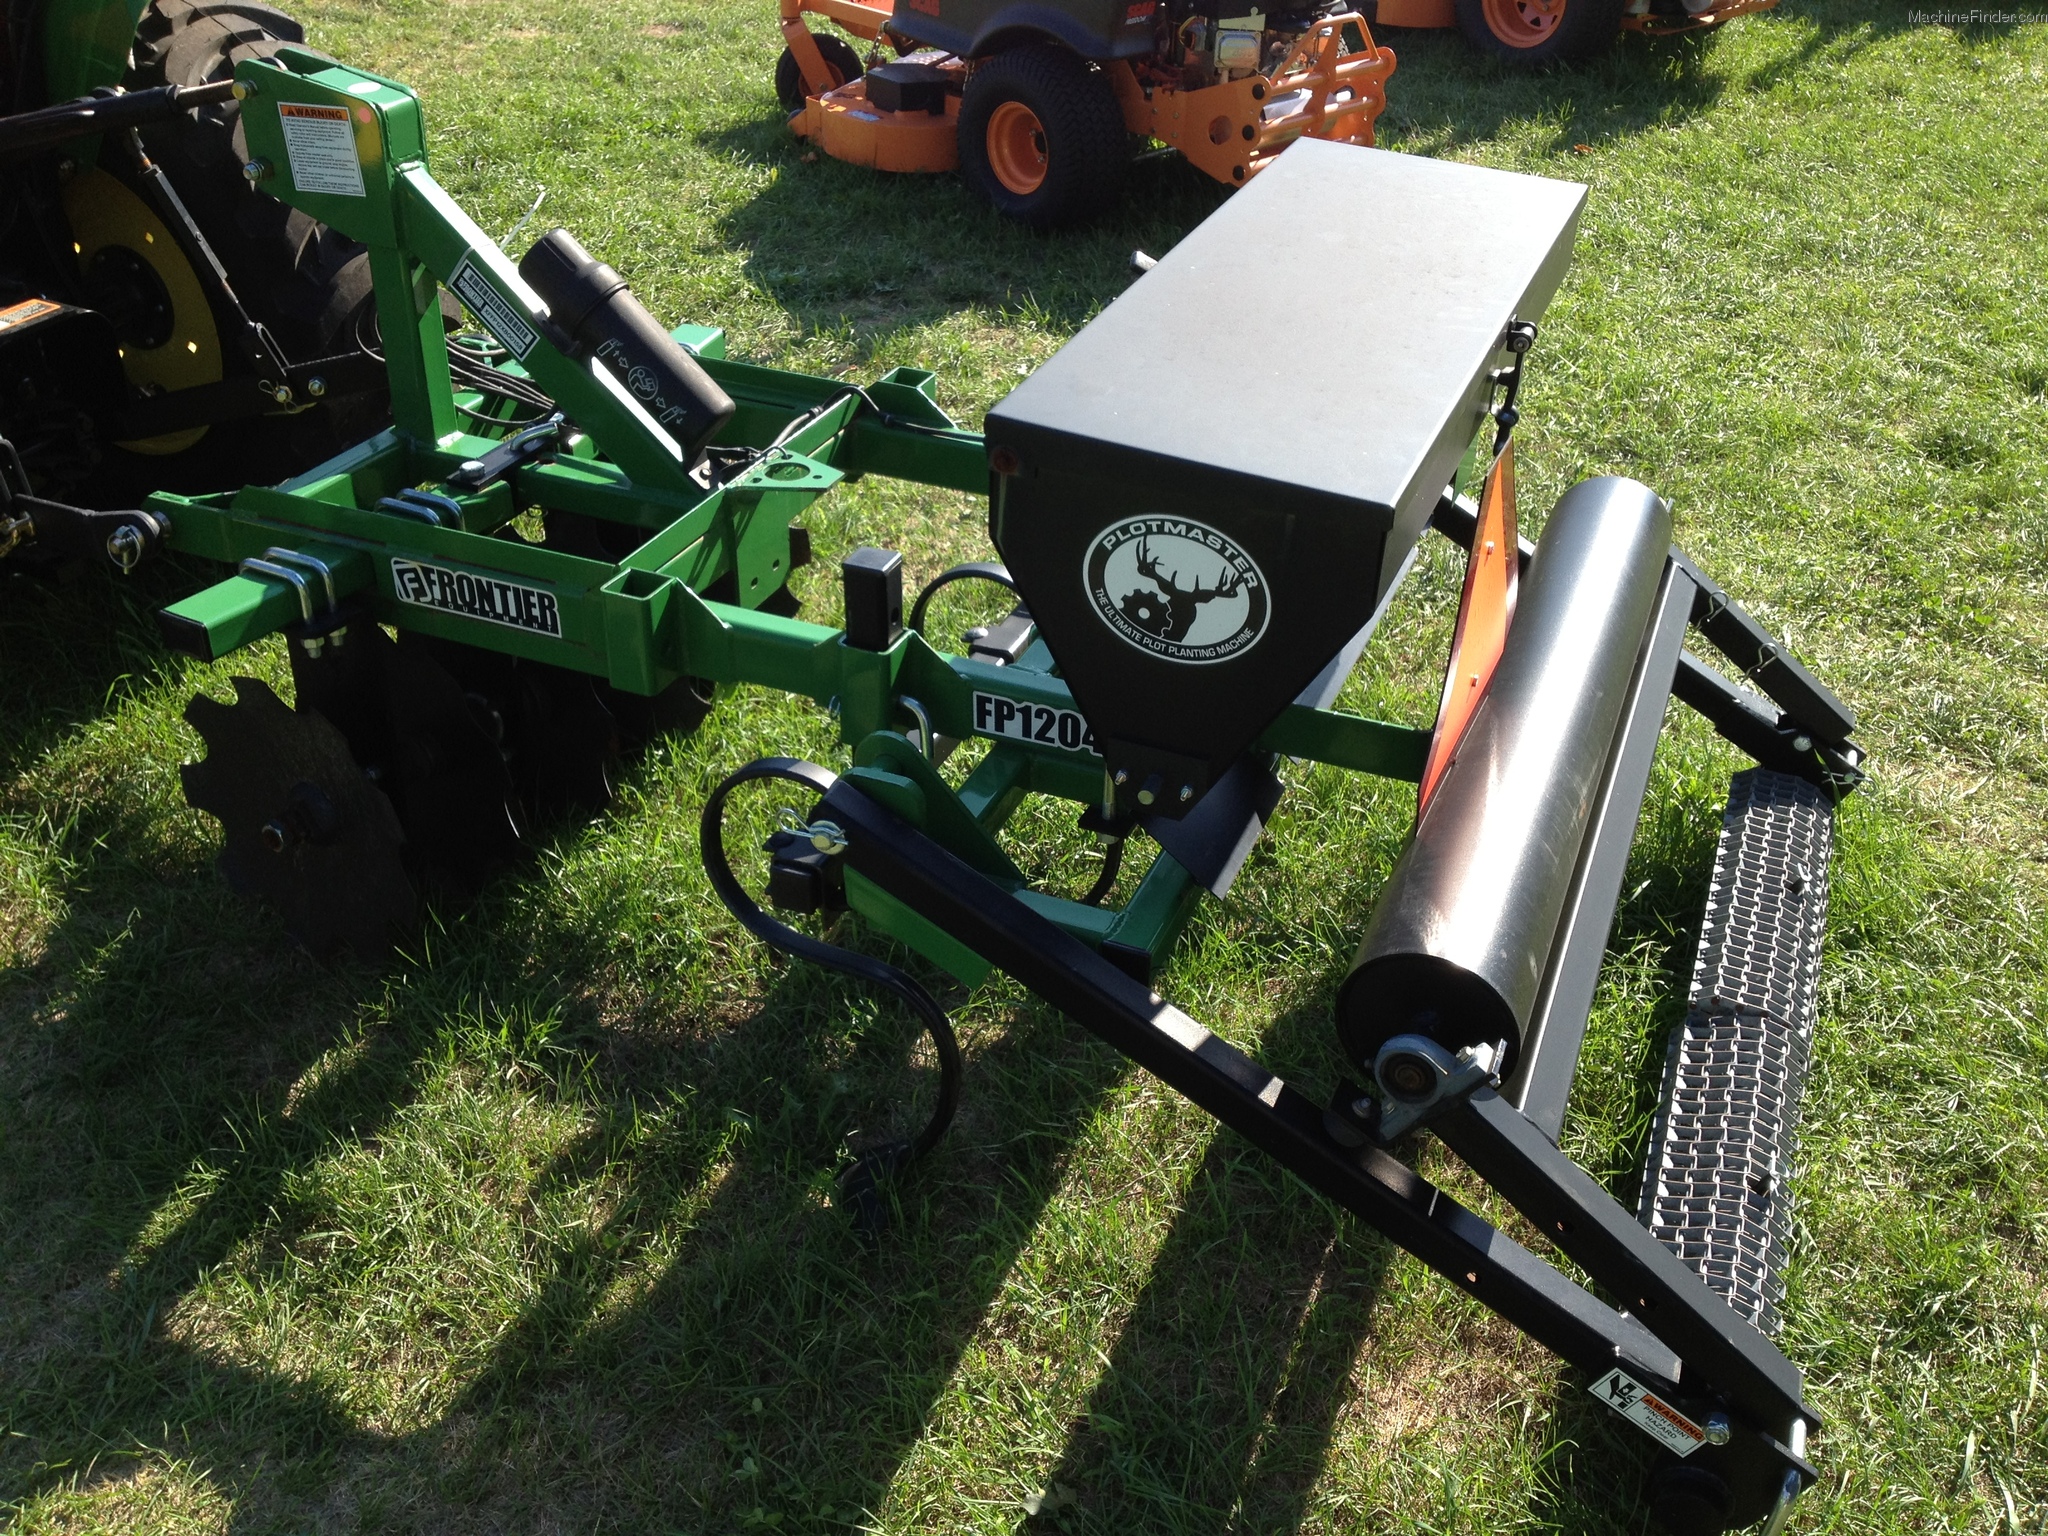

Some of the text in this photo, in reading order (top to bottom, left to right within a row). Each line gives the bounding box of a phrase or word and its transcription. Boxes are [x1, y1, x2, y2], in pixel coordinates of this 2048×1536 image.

[295, 107, 343, 119] WARNING
[1102, 521, 1258, 589] PLOTMASTER
[420, 565, 560, 632] FRONTIER
[434, 599, 553, 633] EQUIPMENT
[1095, 588, 1254, 658] THE ULTIMATE PLOT PLANTING MACHINE
[1643, 1405, 1692, 1440] PINCH POINT
[1645, 1415, 1677, 1439] HAZARD
[1653, 1402, 1704, 1440] WARNING
